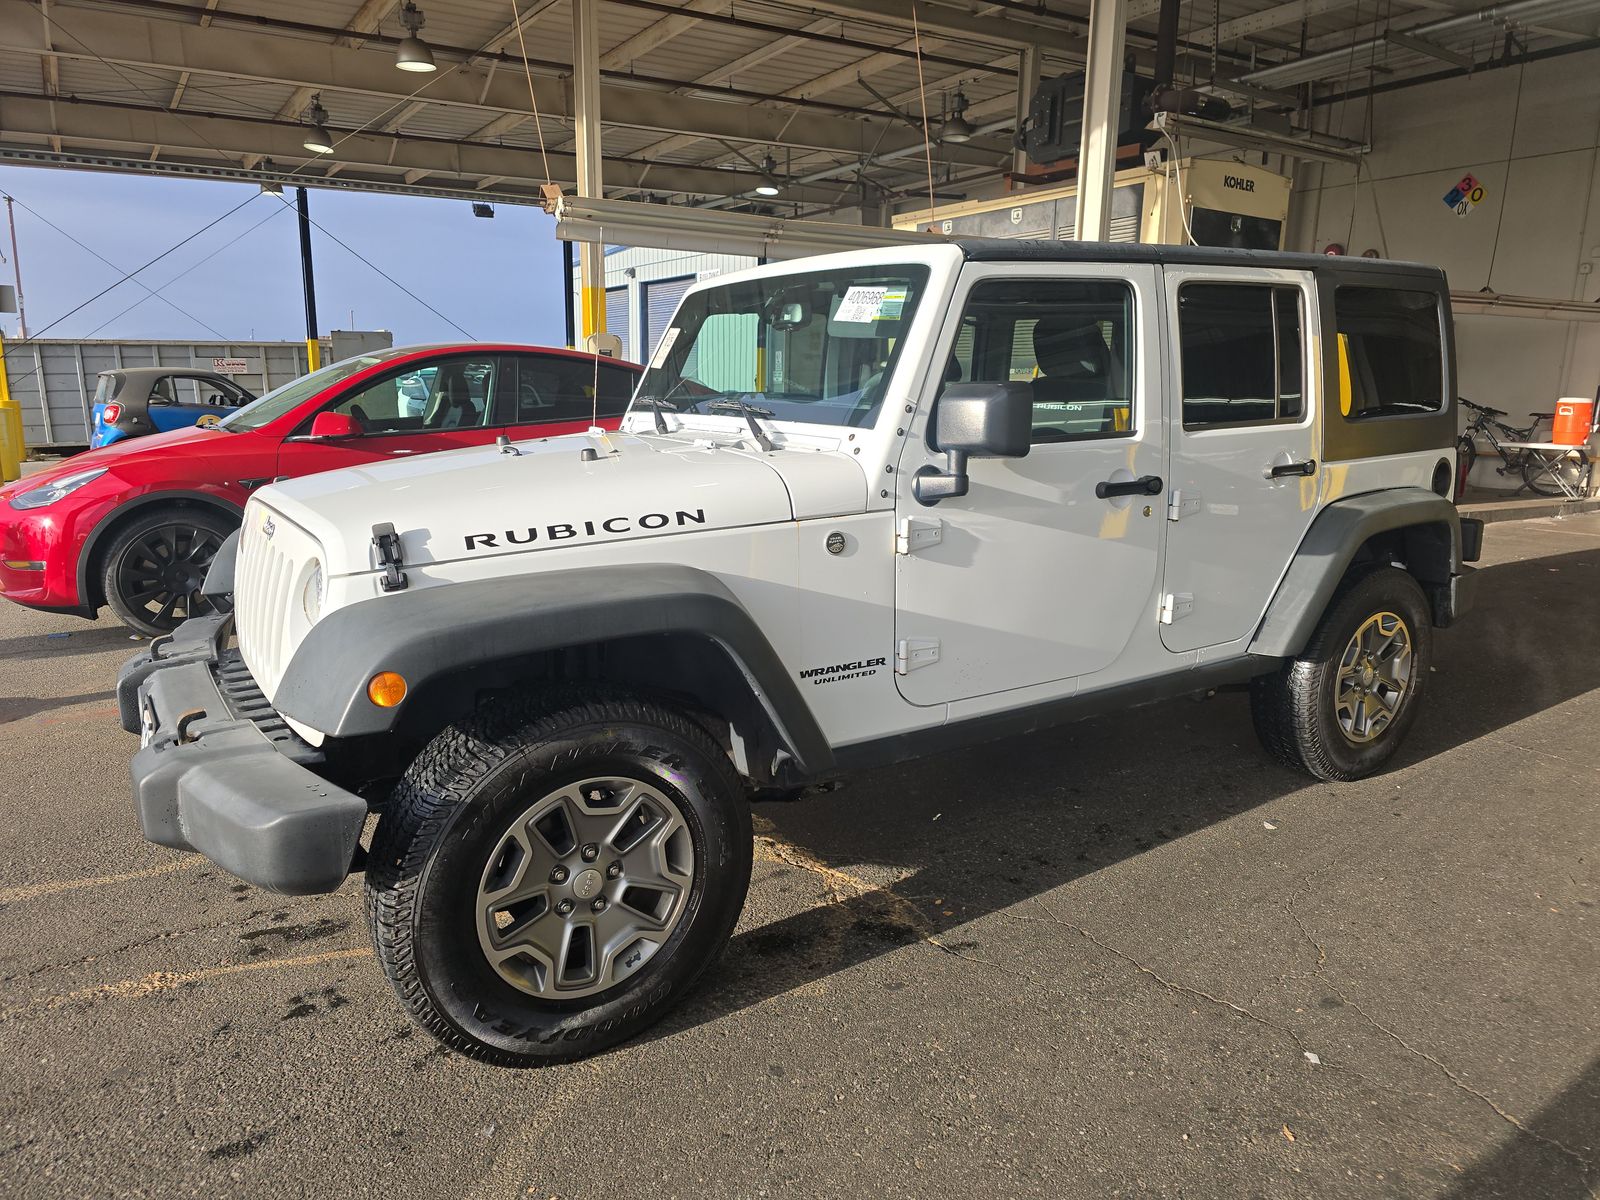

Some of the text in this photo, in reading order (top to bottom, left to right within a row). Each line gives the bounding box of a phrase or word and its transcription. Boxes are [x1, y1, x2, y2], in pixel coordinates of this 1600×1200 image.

[1223, 175, 1254, 192] KOHLER
[1461, 177, 1472, 191] 3
[1471, 187, 1484, 202] 0
[1457, 201, 1470, 215] OX
[464, 508, 706, 550] RUBICON
[799, 657, 886, 679] WRANGLER
[814, 669, 876, 685] UNLIMITED
